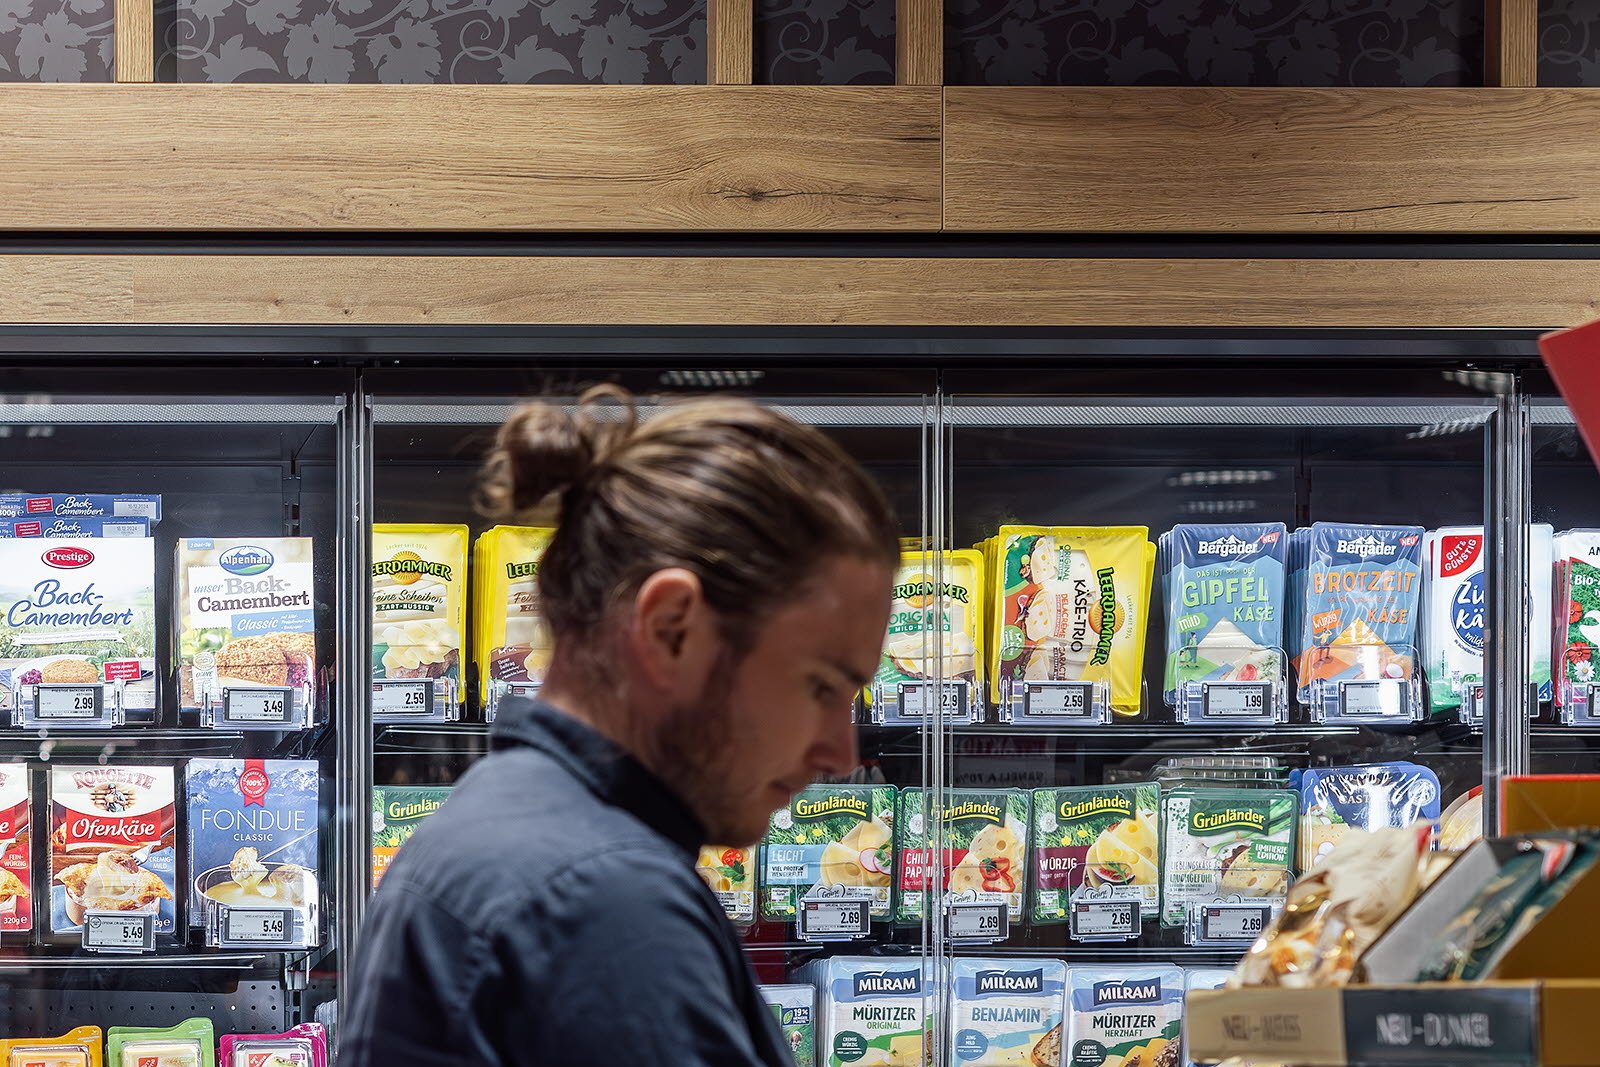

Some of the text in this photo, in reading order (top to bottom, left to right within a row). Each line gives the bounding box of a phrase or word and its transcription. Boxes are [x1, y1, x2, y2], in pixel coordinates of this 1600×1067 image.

[1262, 534, 1277, 543] NEU
[1197, 540, 1258, 557] Bergader
[1336, 539, 1397, 556] Bergader
[1444, 539, 1478, 572] GÜNSTIG
[1446, 539, 1467, 560] GUT&
[49, 551, 90, 562] Prestige
[221, 554, 273, 567] Alpenhain
[193, 574, 292, 596] unser Back-
[1313, 570, 1417, 594] BROTZEIT
[32, 579, 104, 608] Back-
[1182, 577, 1270, 607] GIPFEL
[197, 590, 310, 613] Camembert
[7, 600, 134, 628] Camembert
[1070, 579, 1090, 653] KÄSE-TRIO
[1089, 566, 1114, 666] LEERDAMMER
[1233, 603, 1274, 622] KÄSE
[1367, 607, 1409, 624] KÄSE
[236, 615, 280, 632] Classic
[1063, 694, 1083, 708] 2.59
[1245, 695, 1262, 708] 1.99
[796, 795, 868, 817] Grünländer
[1060, 796, 1132, 816] Grünländer
[201, 808, 306, 831] FONDUE
[1193, 811, 1265, 829] Grünländer
[71, 818, 156, 841] Ofenkäse
[233, 832, 273, 842] CLASSIC
[772, 849, 805, 862] LEICHT
[1039, 857, 1078, 871] WÜRZIG
[1257, 852, 1285, 861] EDITION
[3, 918, 20, 926] 320g
[263, 919, 283, 933] 5.49
[1242, 916, 1261, 931] 2.69
[123, 926, 143, 940] 5.49
[858, 976, 917, 992] MILRAM
[980, 975, 1039, 991] MILRAM
[793, 1008, 809, 1017] 19%
[853, 1004, 917, 1021] MÜRITZER
[971, 1006, 1041, 1023] BENJAMIN
[1092, 1012, 1157, 1029] MÜRITZER
[866, 1021, 902, 1030] ORIGINAL
[1104, 1028, 1144, 1038] HERZHAFT
